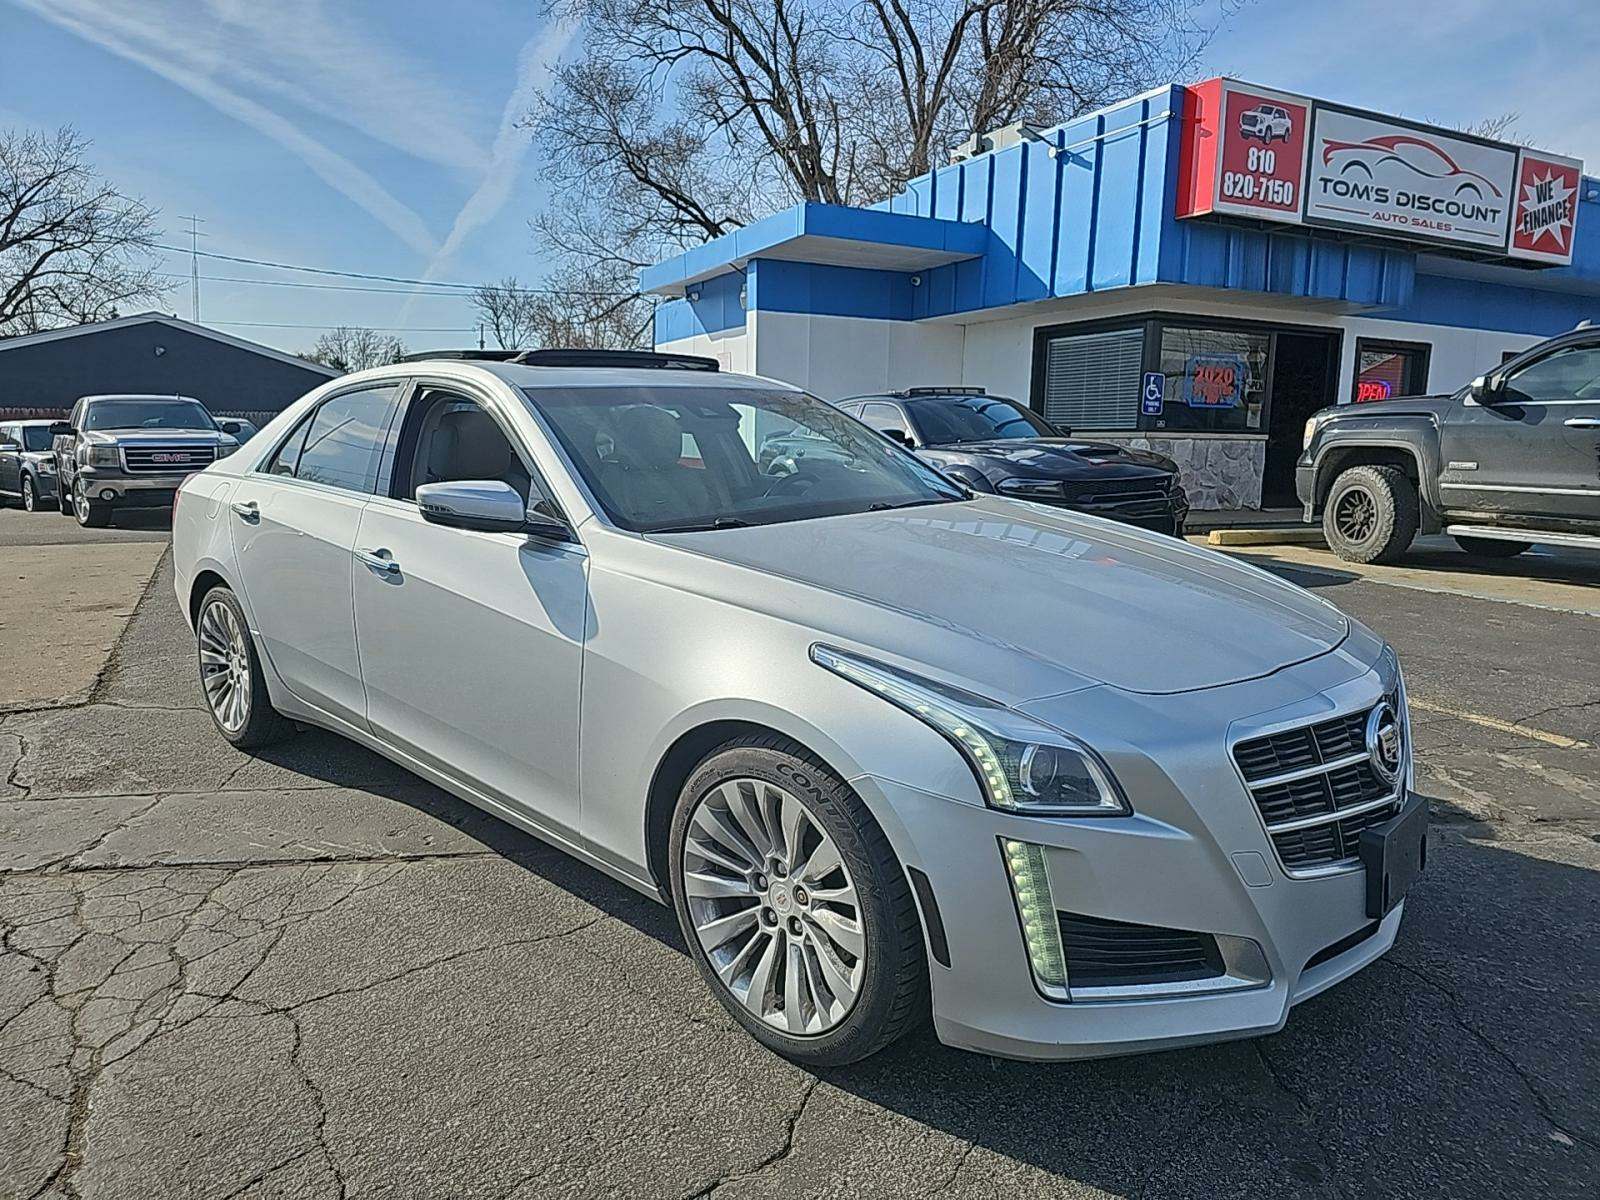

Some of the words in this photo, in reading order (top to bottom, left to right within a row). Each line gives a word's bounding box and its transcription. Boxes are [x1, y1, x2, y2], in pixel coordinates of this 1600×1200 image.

[1248, 147, 1276, 175] 810
[1223, 171, 1294, 205] 820-7150
[1319, 177, 1389, 204] TOM'S
[1396, 191, 1501, 223] DISCOUNT
[1535, 180, 1554, 204] WE
[1371, 211, 1408, 225] AUTO
[1411, 218, 1452, 232] SALES
[1523, 199, 1570, 233] FINANCE
[151, 453, 191, 462] GMC
